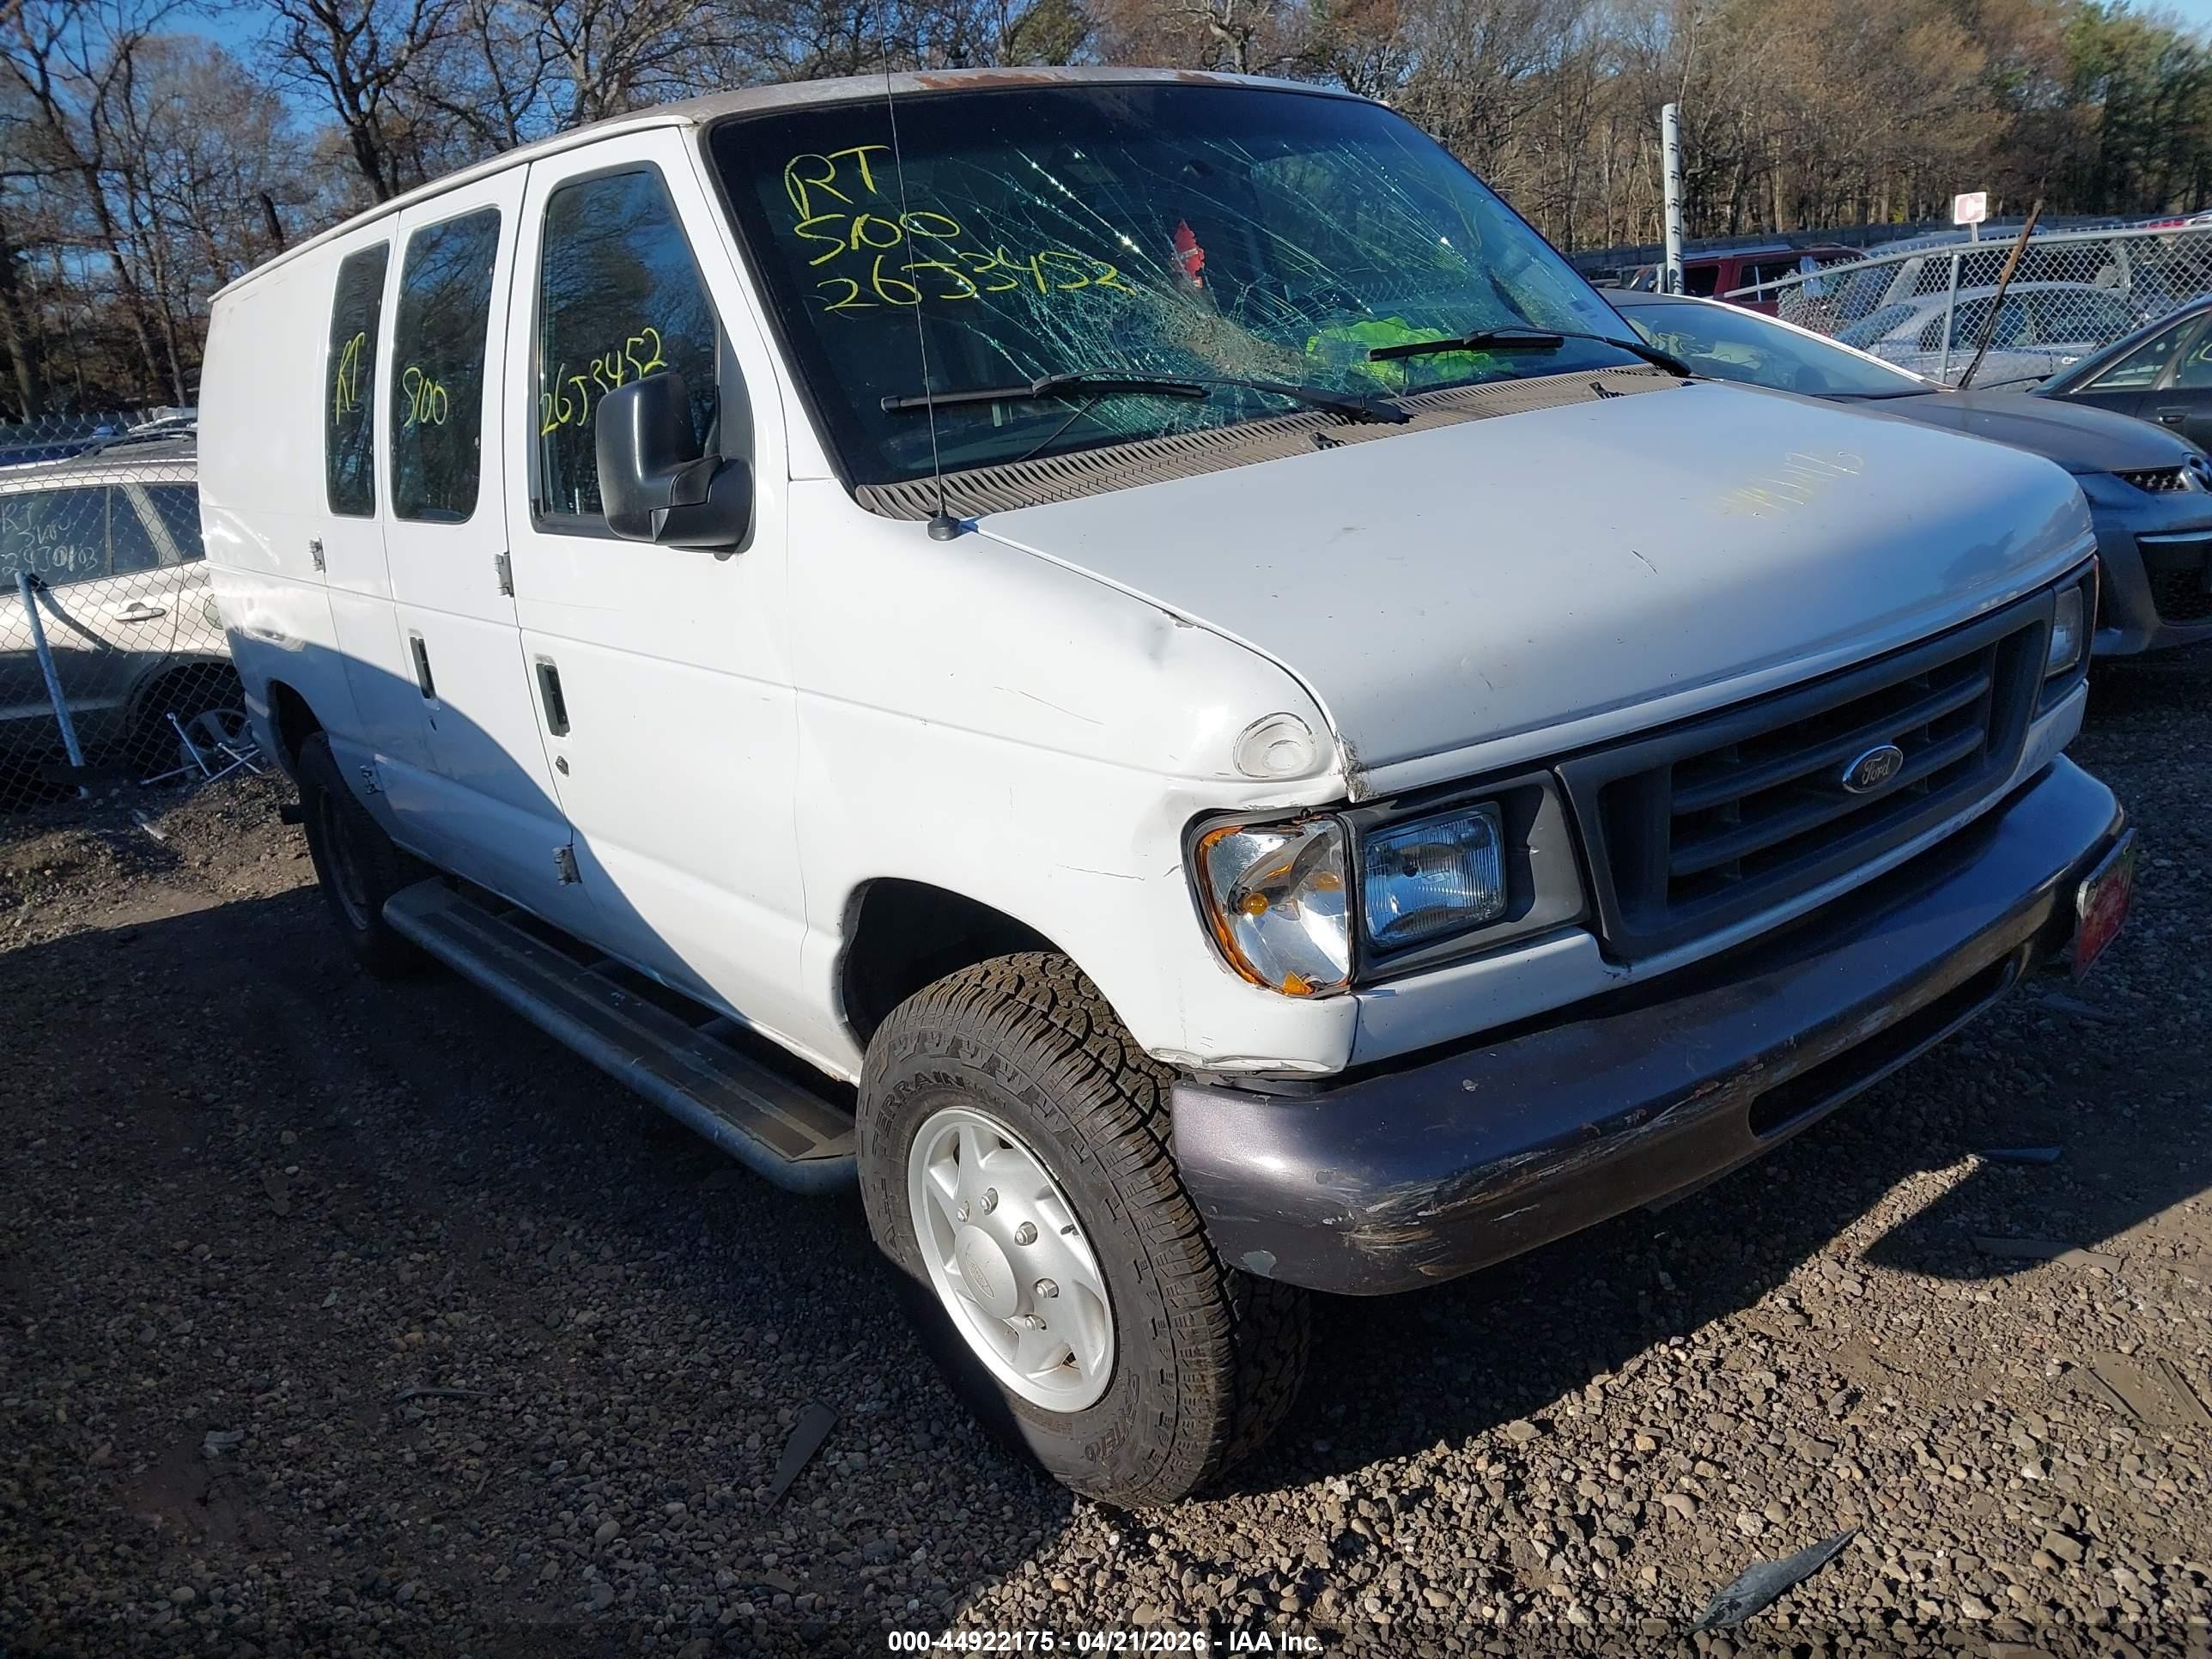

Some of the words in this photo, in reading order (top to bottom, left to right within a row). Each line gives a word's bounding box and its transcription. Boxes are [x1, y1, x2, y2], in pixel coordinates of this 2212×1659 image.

[785, 144, 890, 220] RT
[1862, 755, 1891, 785] Ford
[872, 1070, 967, 1157] TERRAIN
